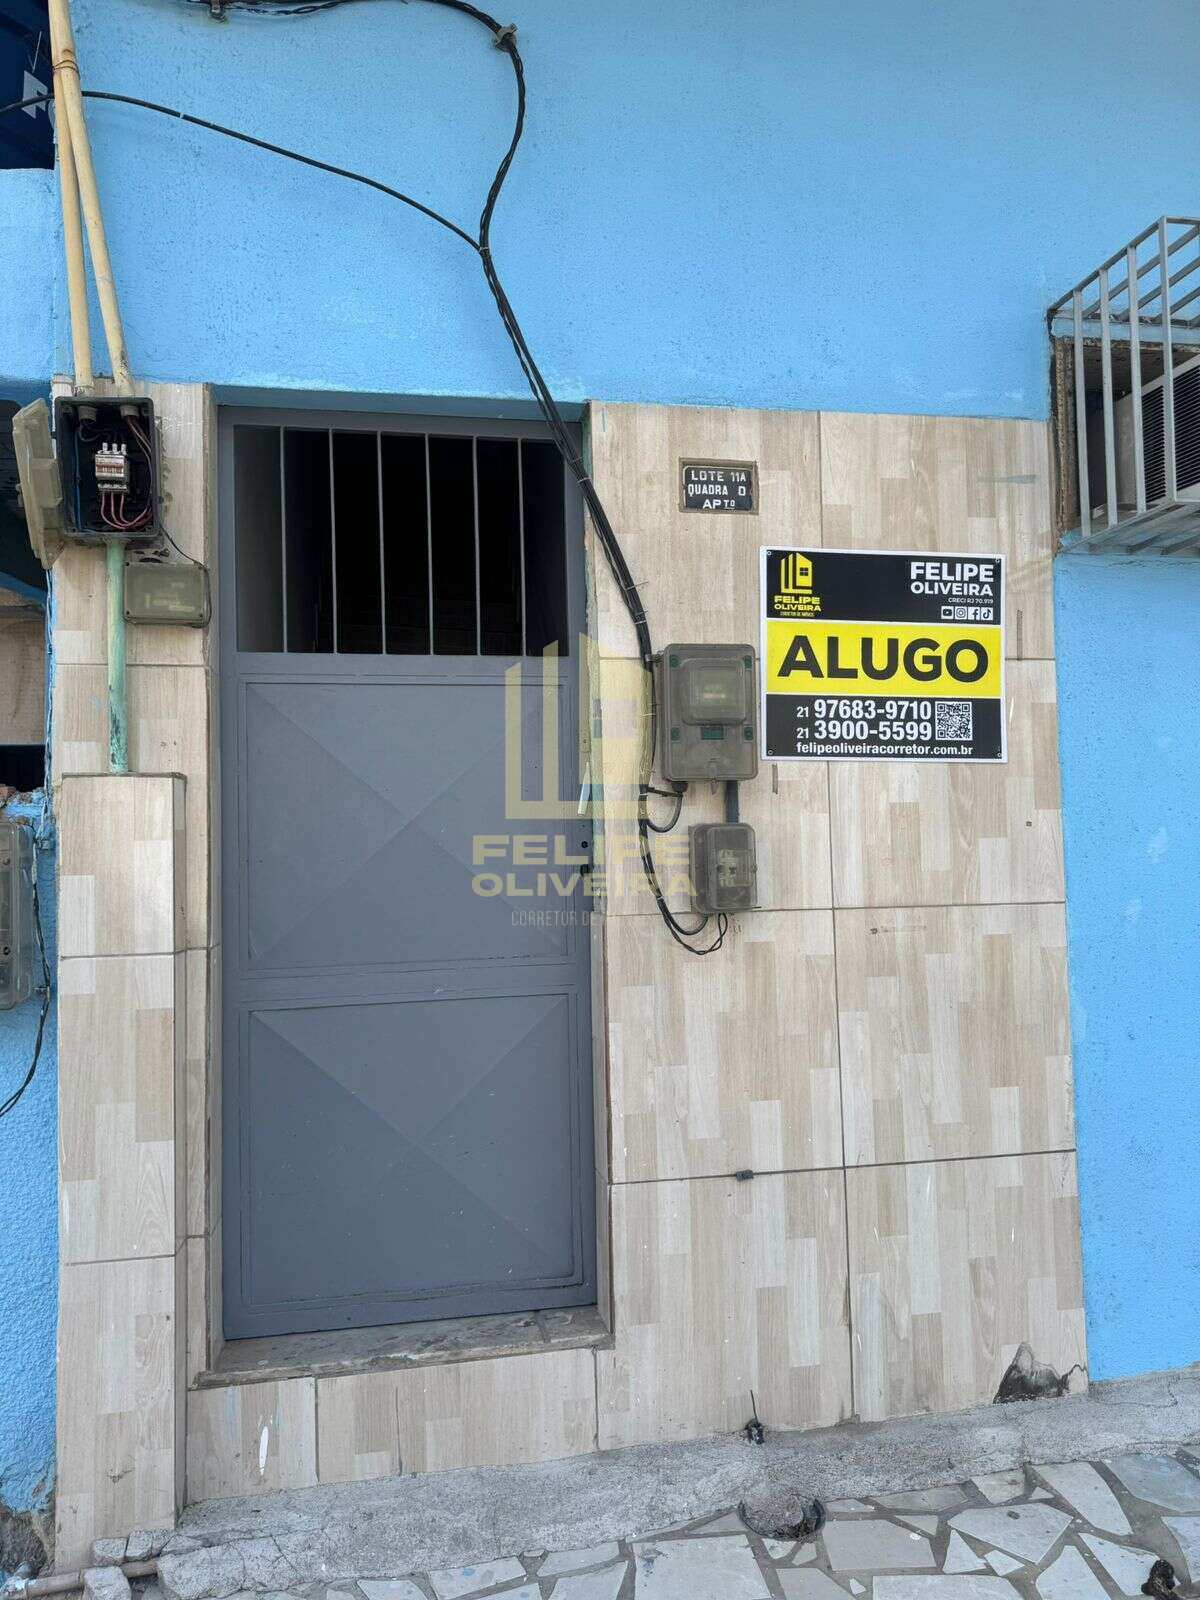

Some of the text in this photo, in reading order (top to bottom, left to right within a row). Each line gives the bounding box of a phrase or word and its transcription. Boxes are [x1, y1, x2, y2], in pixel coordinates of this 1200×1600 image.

[691, 470, 746, 482] LOTE 11A
[687, 484, 728, 497] QUADRA
[910, 561, 994, 582] FELIPE
[910, 581, 993, 596] OLIVEIRA
[774, 595, 821, 605] FELIPE
[774, 603, 822, 612] OLIVEIRA
[777, 635, 989, 683] ALUGO
[796, 699, 932, 720] 21 97683-9710
[796, 720, 932, 741] 21 3900-5599
[796, 742, 973, 756] felipeoliveiracorretor.com.br
